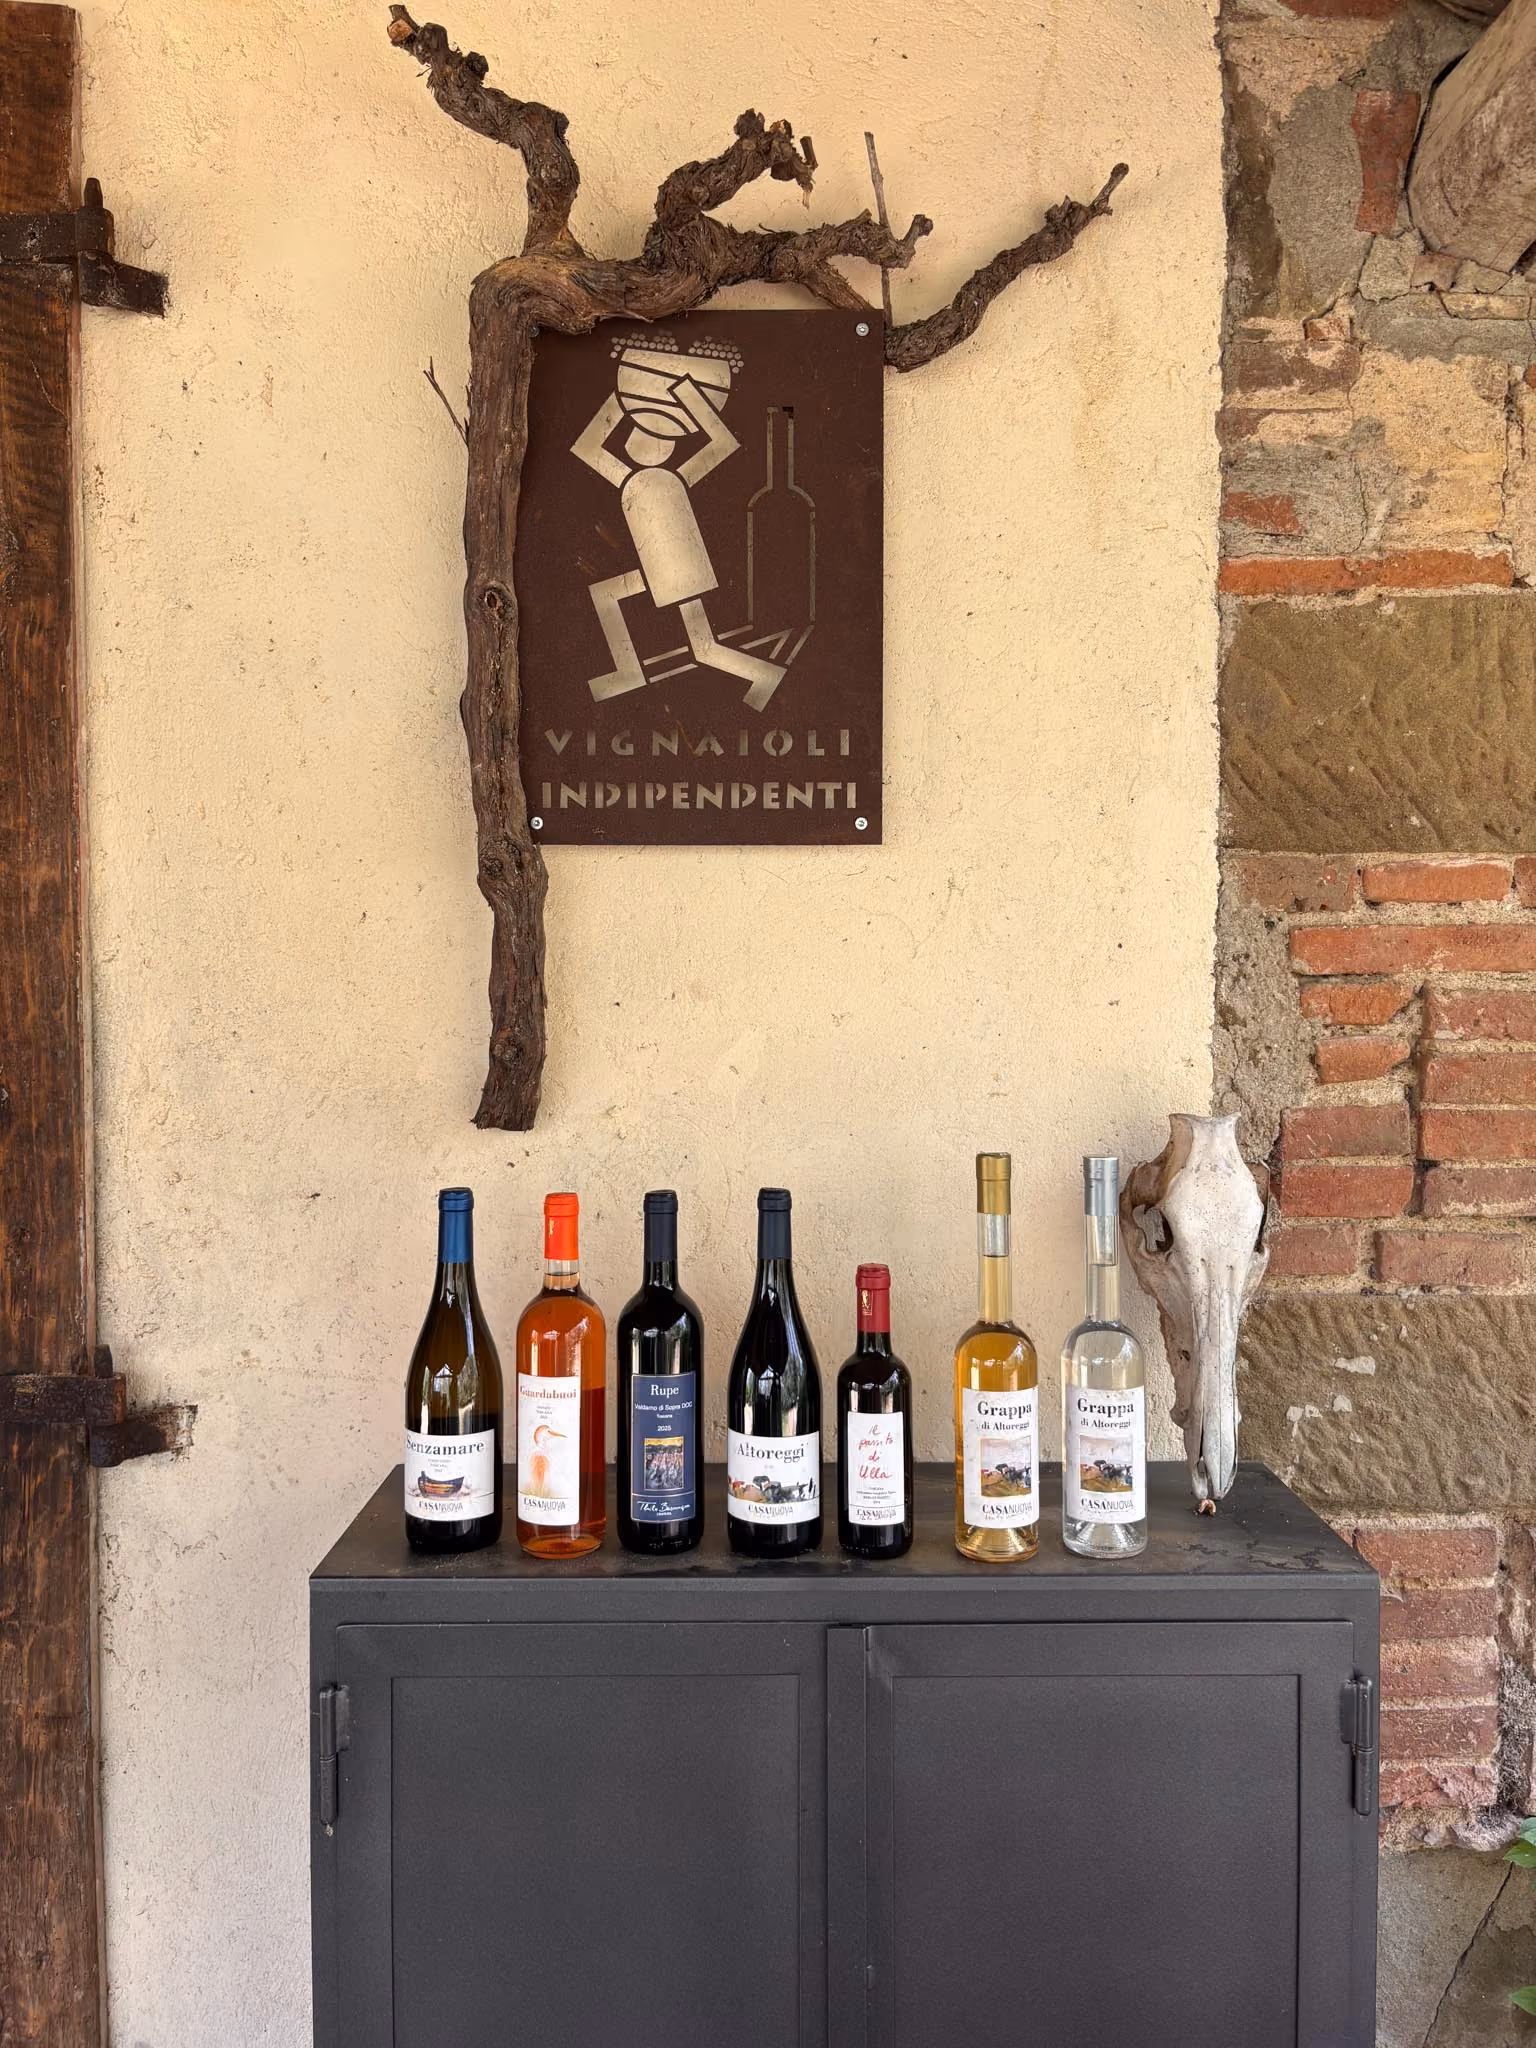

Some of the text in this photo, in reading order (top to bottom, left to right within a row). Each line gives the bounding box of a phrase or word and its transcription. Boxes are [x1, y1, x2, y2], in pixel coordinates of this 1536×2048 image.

[544, 729, 850, 757] VIGNAIOLI
[542, 782, 857, 809] INDIPENDENTI
[519, 1385, 577, 1399] Guardabuoi
[650, 1384, 680, 1399] Rupe
[977, 1400, 1032, 1419] Grappa
[1077, 1397, 1134, 1418] Grappa
[981, 1421, 1030, 1431] di Altoreggi
[1080, 1417, 1131, 1430] di Altoreggi
[406, 1434, 485, 1456] Senzamare
[737, 1441, 805, 1464] Altoreggi
[858, 1465, 893, 1480] Ulla
[748, 1504, 794, 1517] CASANUOVA
[982, 1502, 1033, 1515] CASANUOVA
[1080, 1497, 1134, 1510] CASANUOVA
